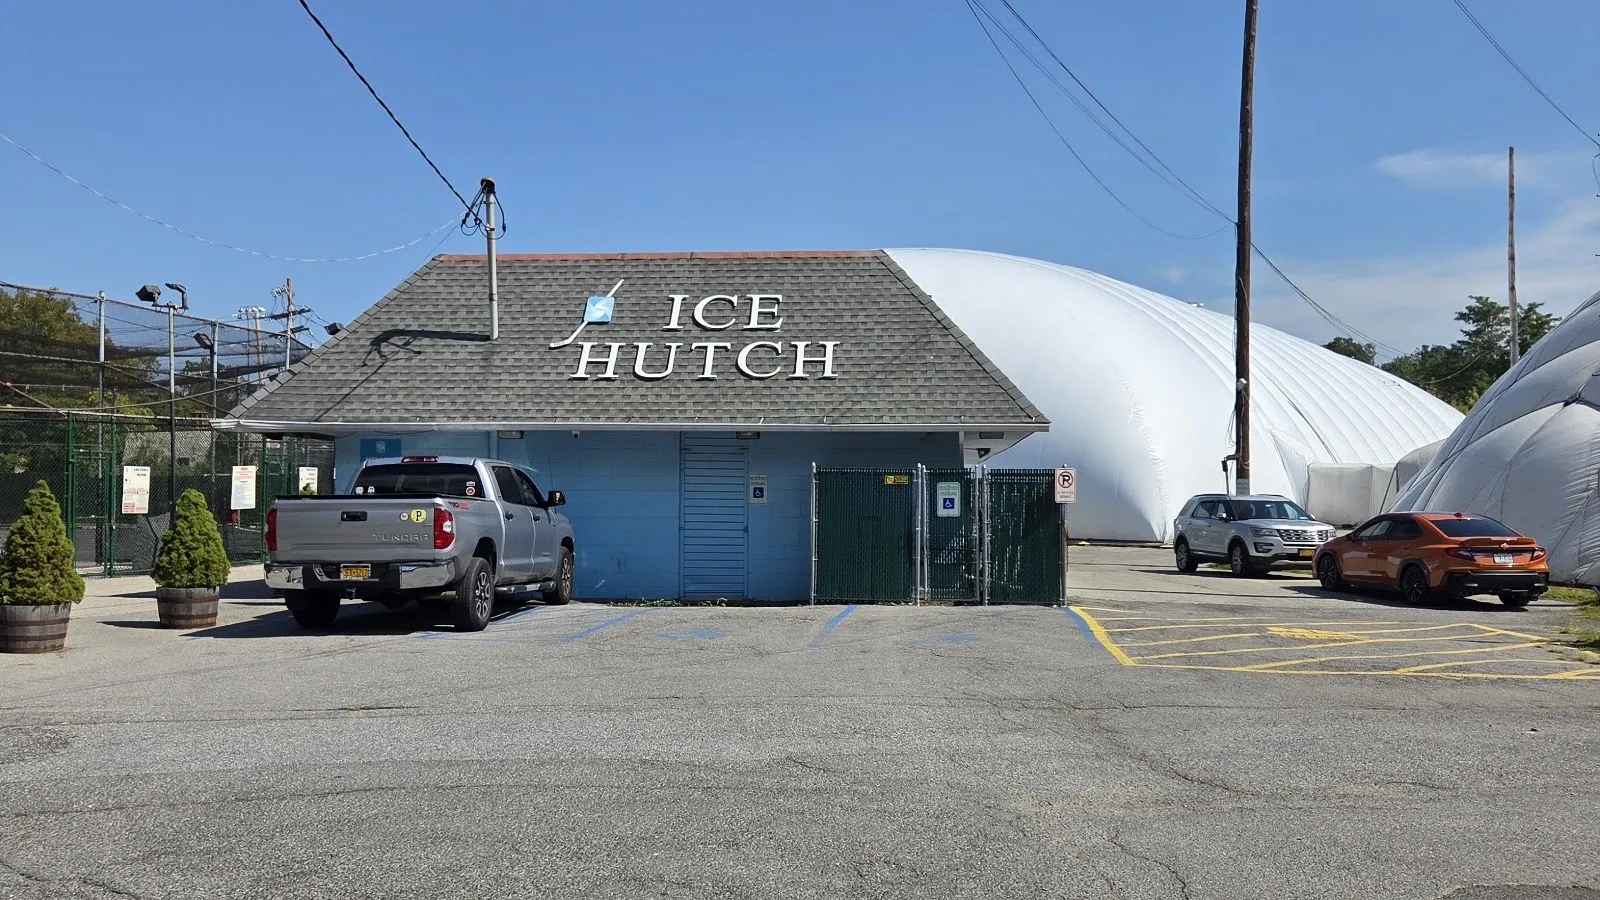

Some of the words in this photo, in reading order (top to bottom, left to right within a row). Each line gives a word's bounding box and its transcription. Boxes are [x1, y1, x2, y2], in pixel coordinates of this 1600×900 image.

[662, 294, 783, 330] ICE
[569, 341, 841, 379] HUTCH
[415, 510, 422, 521] P
[372, 533, 429, 541] TUNDRA
